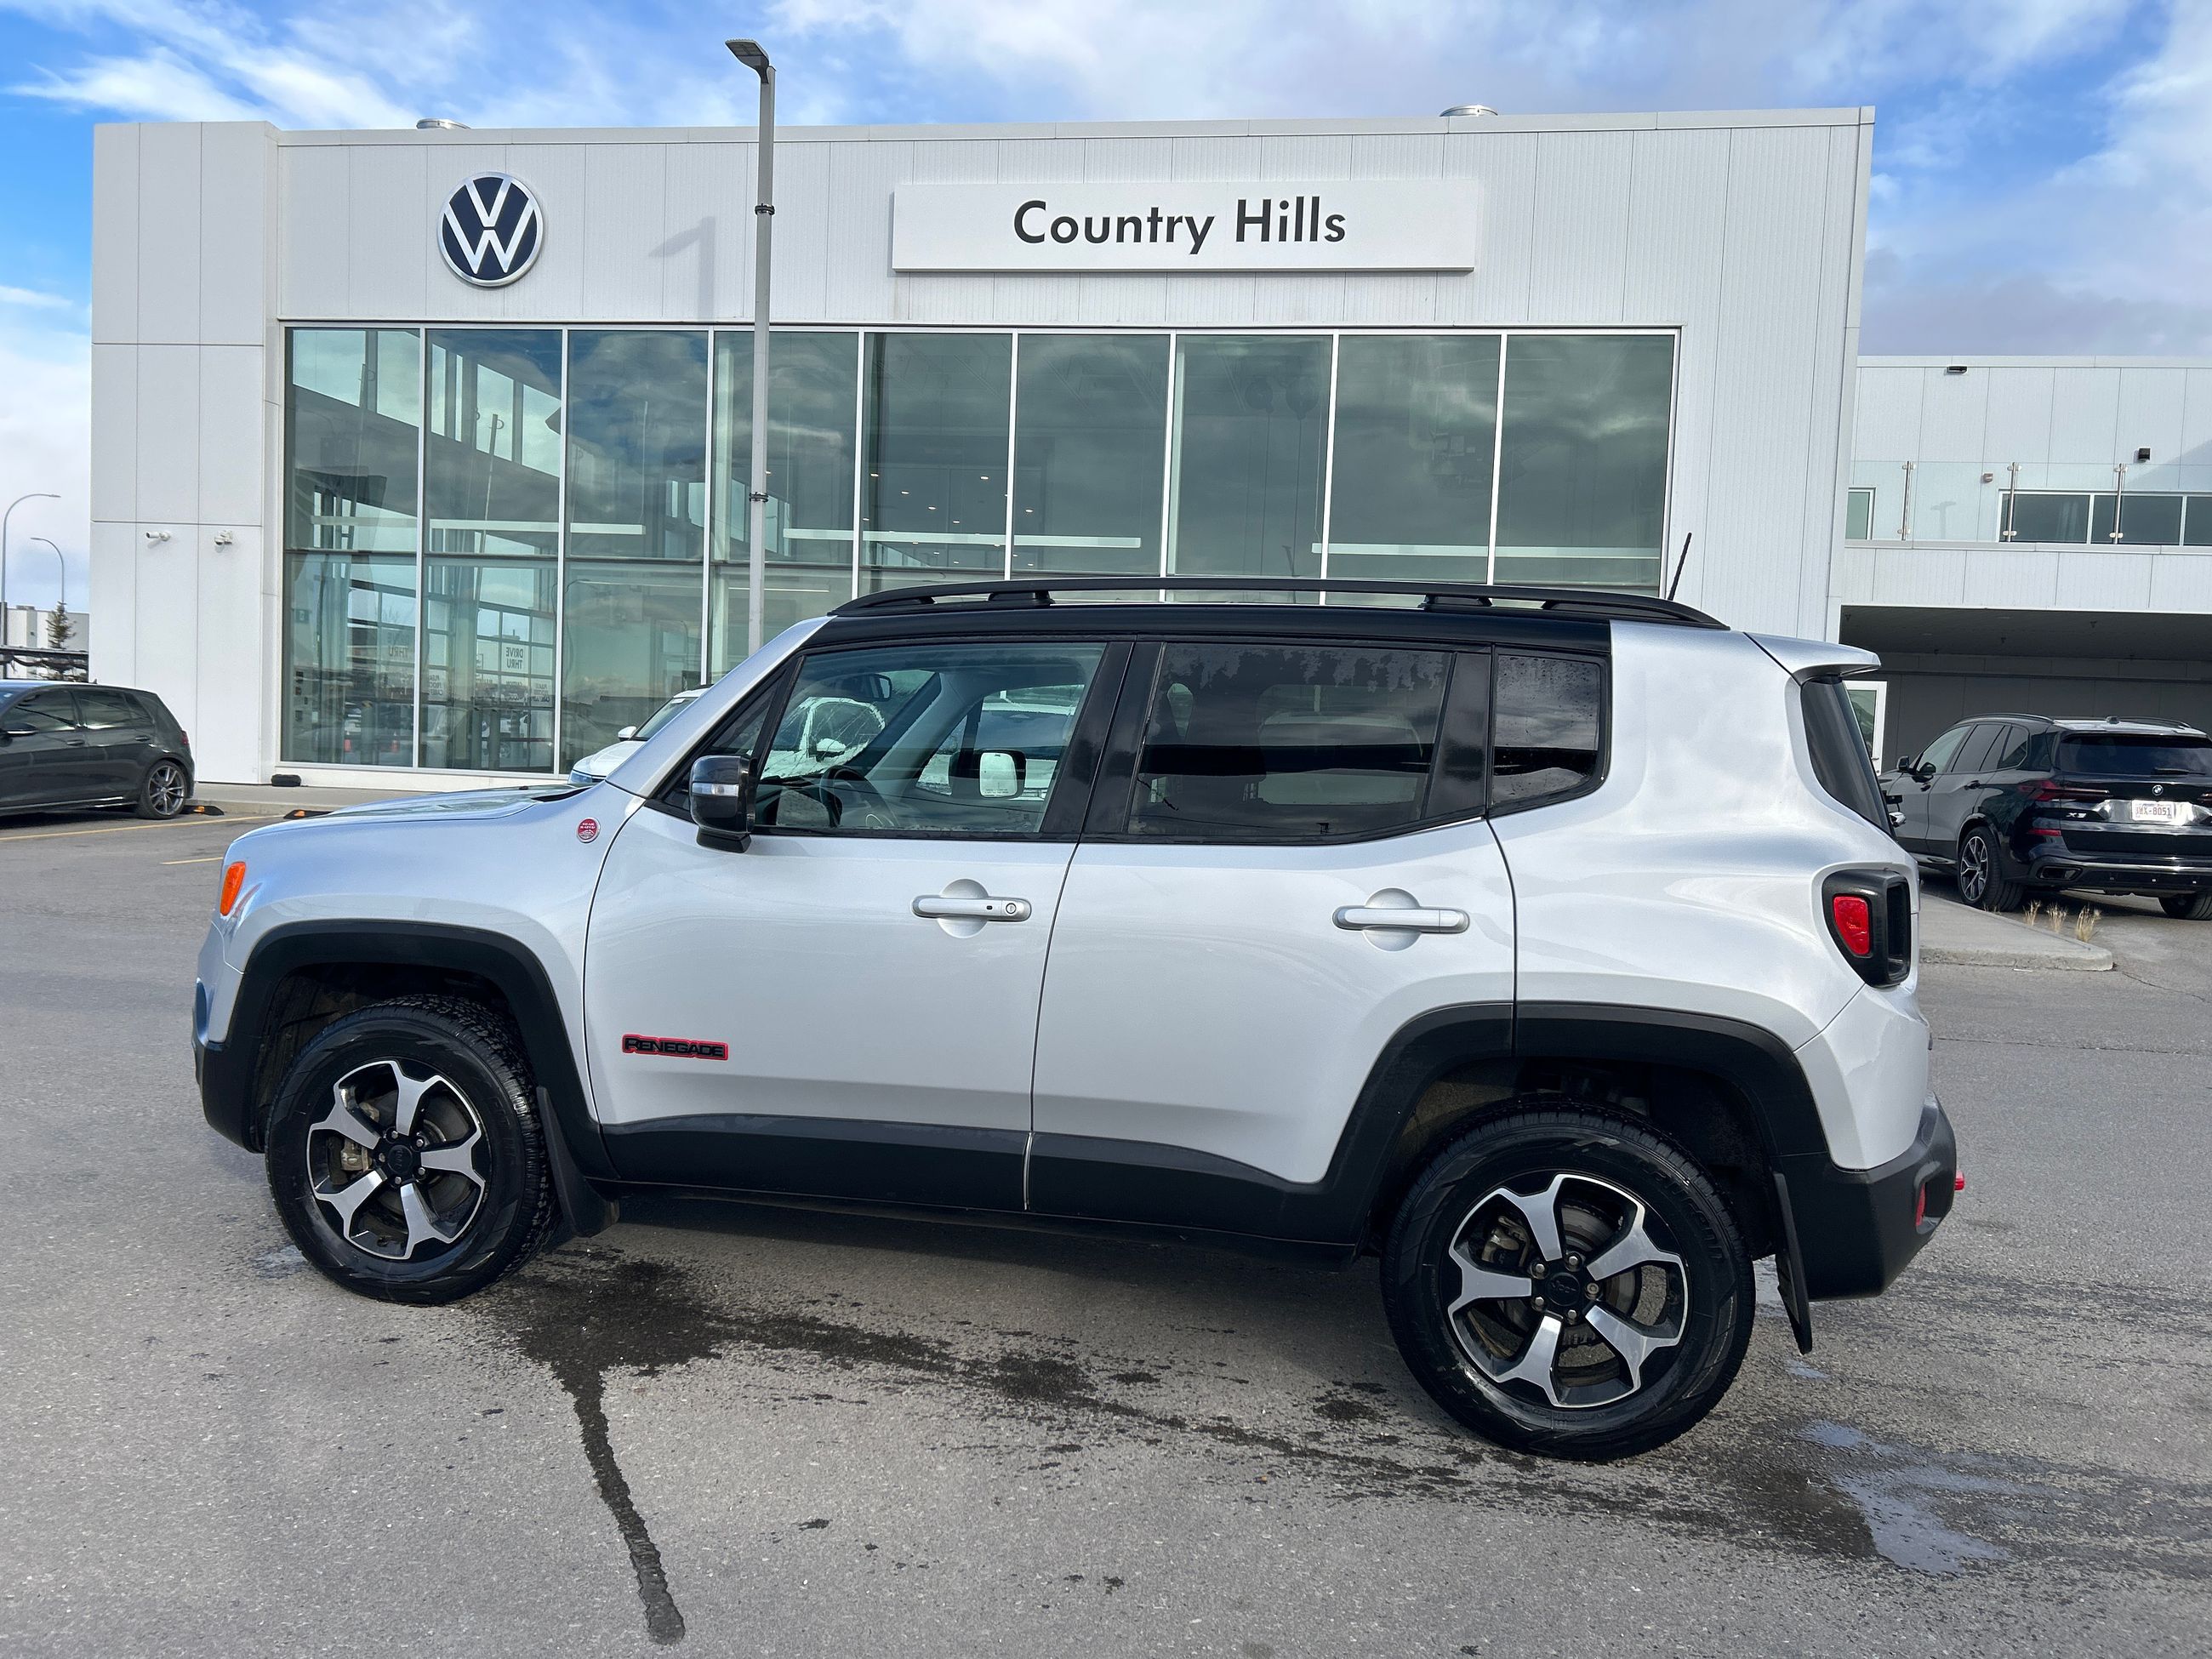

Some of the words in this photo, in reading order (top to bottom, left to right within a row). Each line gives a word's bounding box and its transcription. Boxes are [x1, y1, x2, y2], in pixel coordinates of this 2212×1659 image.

[442, 175, 537, 275] VW
[1014, 200, 1215, 255] Country
[1236, 196, 1346, 242] Hills
[624, 1036, 727, 1058] RENEGADE
